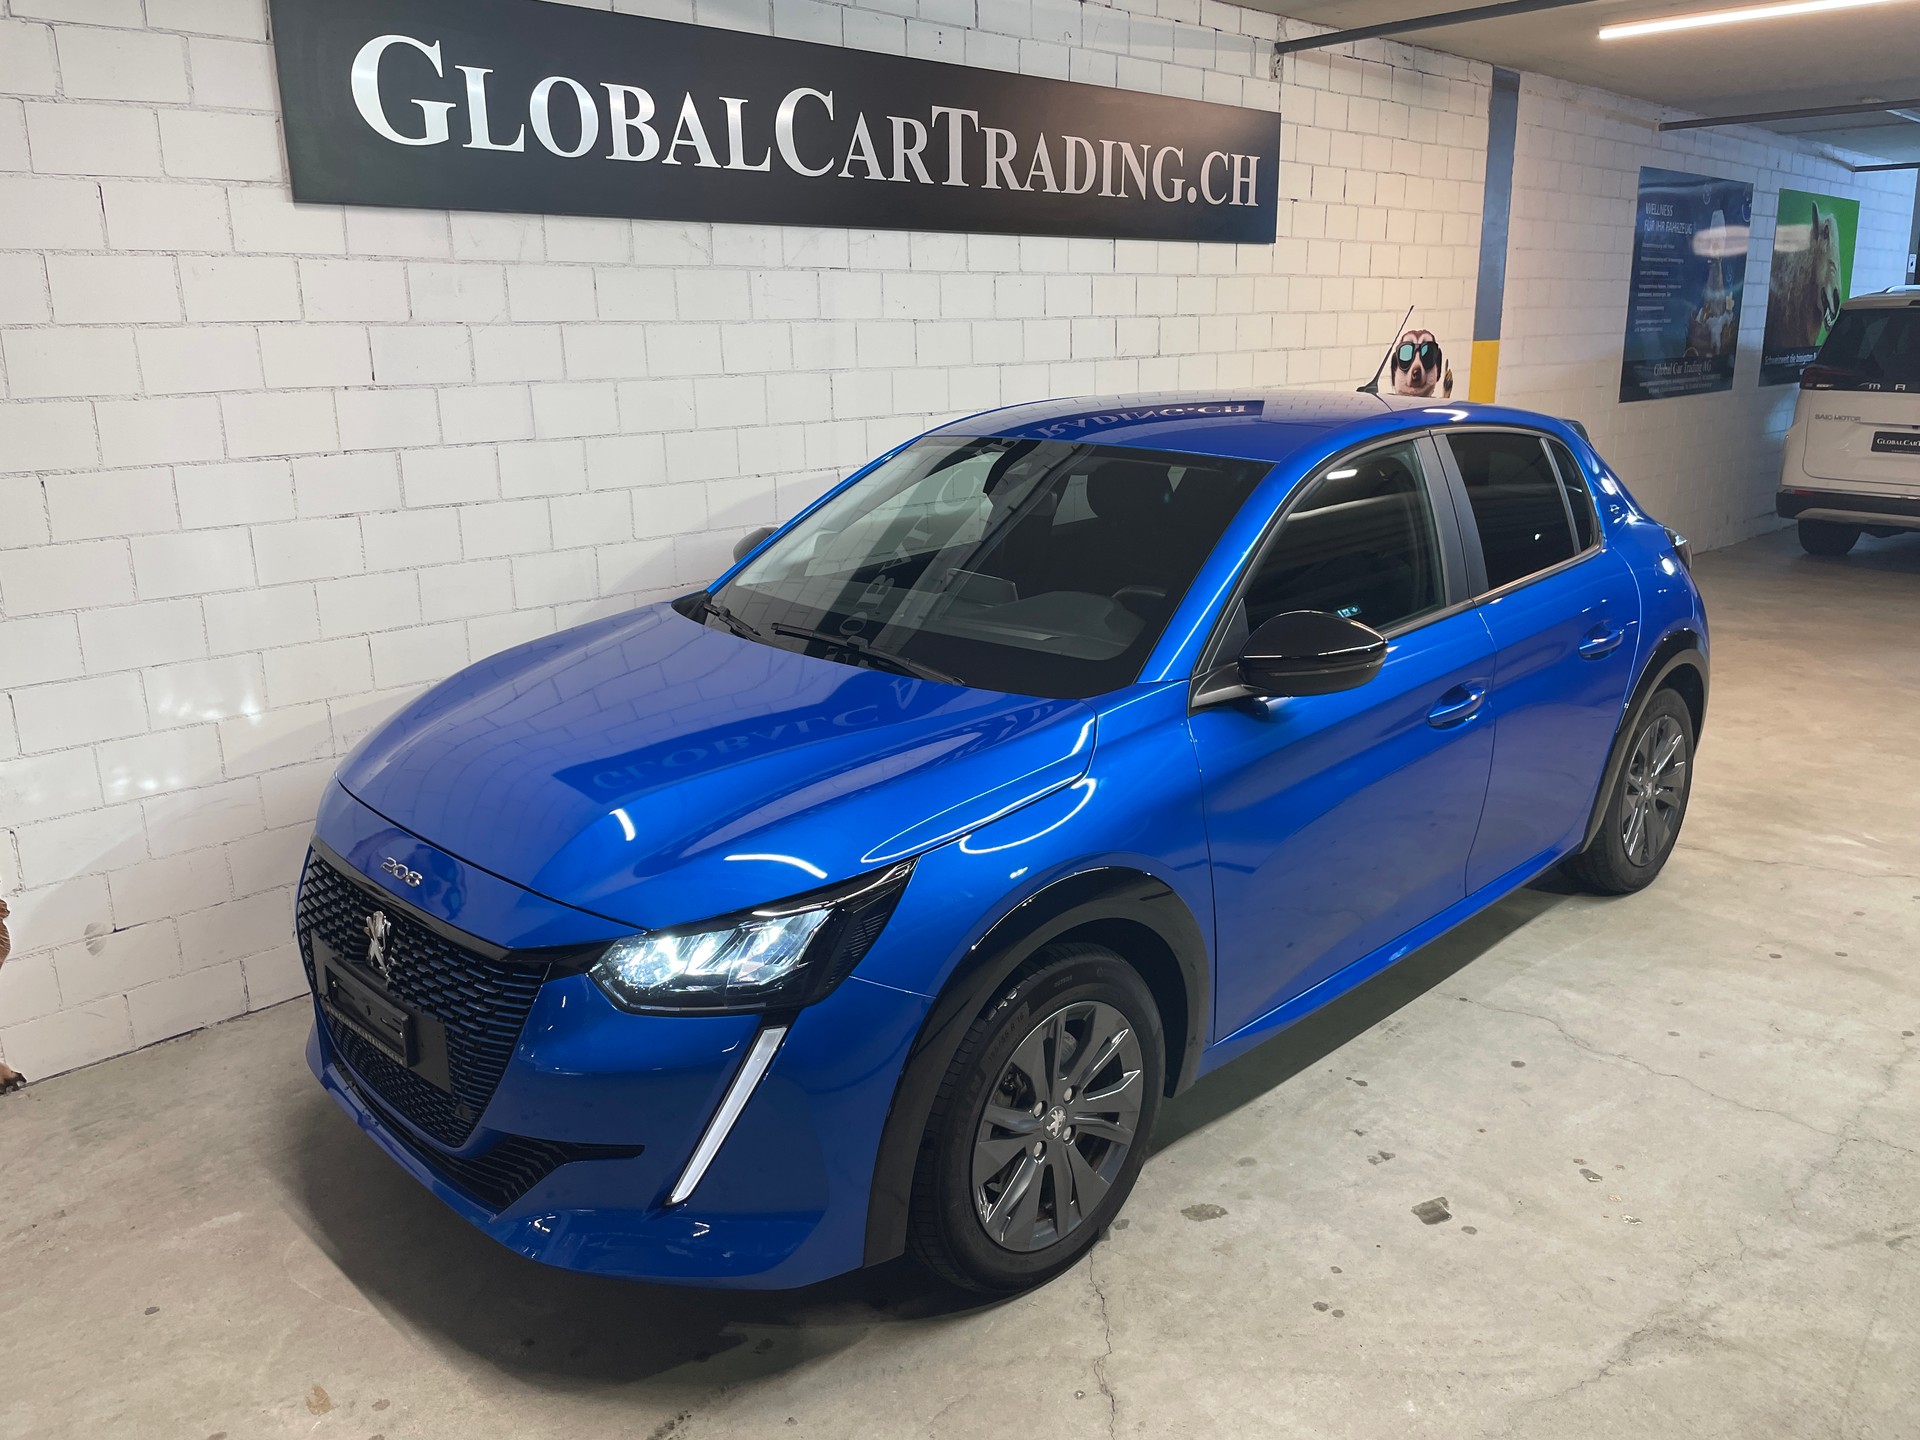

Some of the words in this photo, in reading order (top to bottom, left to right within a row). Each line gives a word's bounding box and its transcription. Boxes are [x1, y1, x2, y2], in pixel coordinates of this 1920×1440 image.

[350, 34, 1259, 208] GLOBALCARTRADING.CH
[1645, 202, 1674, 217] WELLNESS
[1644, 217, 1655, 232] FÜR
[1666, 221, 1693, 235] FAHRZEUG
[1653, 363, 1673, 377] Global
[1673, 362, 1683, 375] Car
[1684, 361, 1702, 376] Trading
[1703, 360, 1712, 373] AG
[1834, 415, 1861, 423] MOTOR
[380, 856, 423, 887] 208
